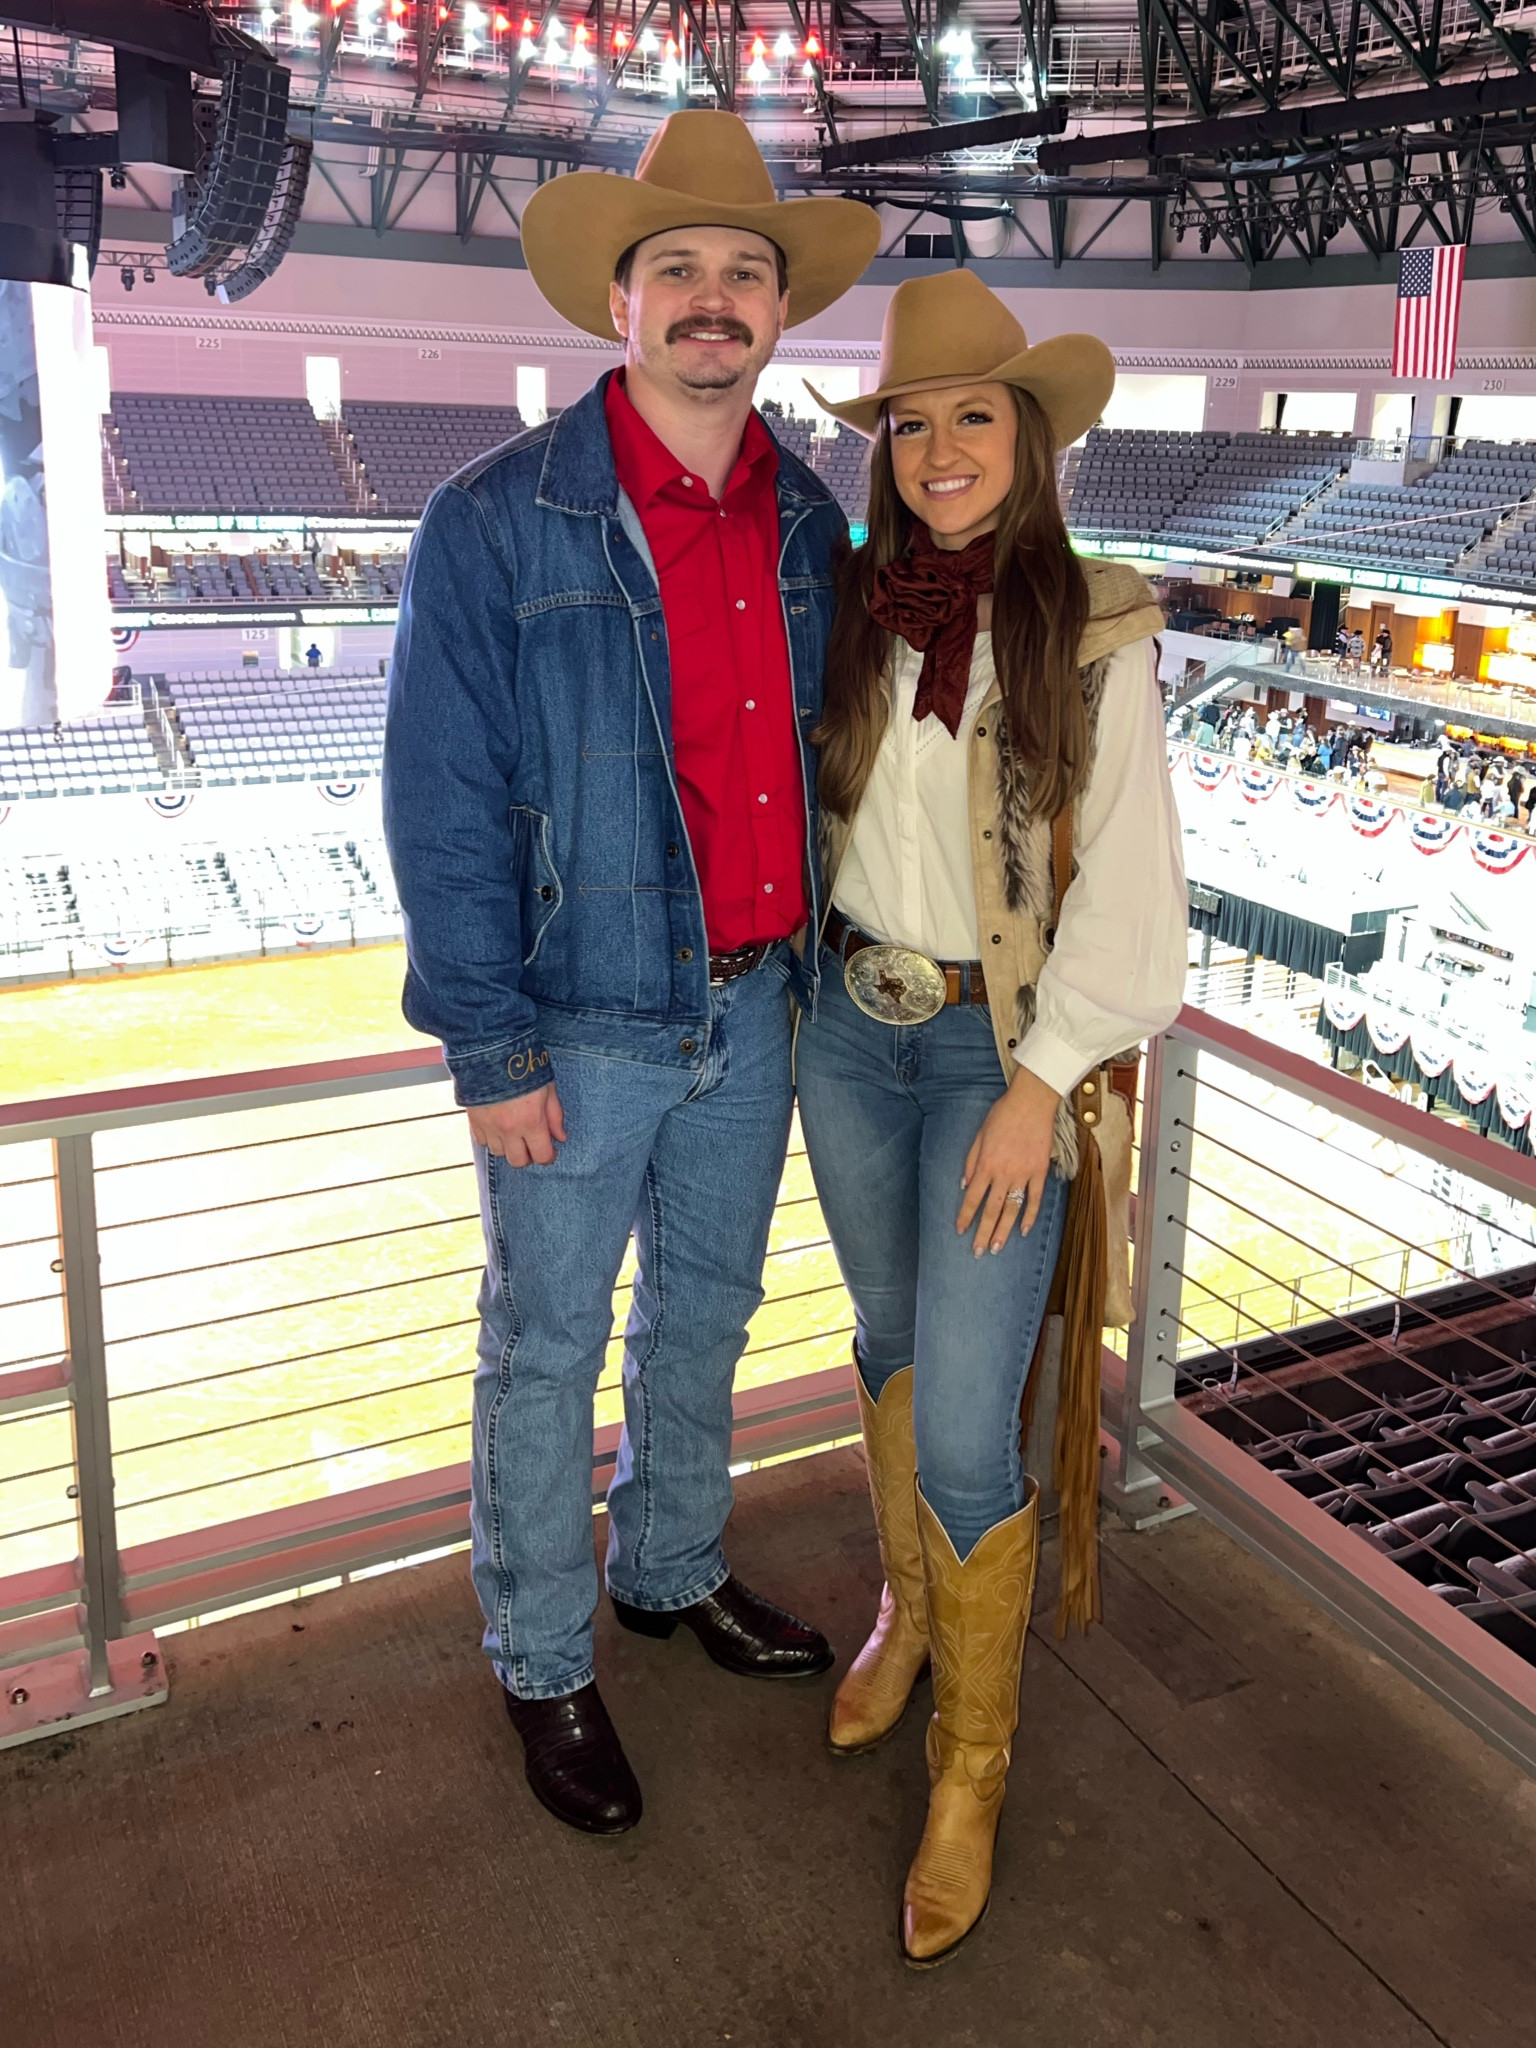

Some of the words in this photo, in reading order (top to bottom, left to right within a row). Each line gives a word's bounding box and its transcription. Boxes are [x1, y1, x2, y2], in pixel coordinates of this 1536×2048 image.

[199, 338, 219, 348] 225
[421, 349, 440, 359] 226
[1215, 377, 1236, 387] 229
[1484, 379, 1503, 391] 230
[245, 630, 266, 640] 125
